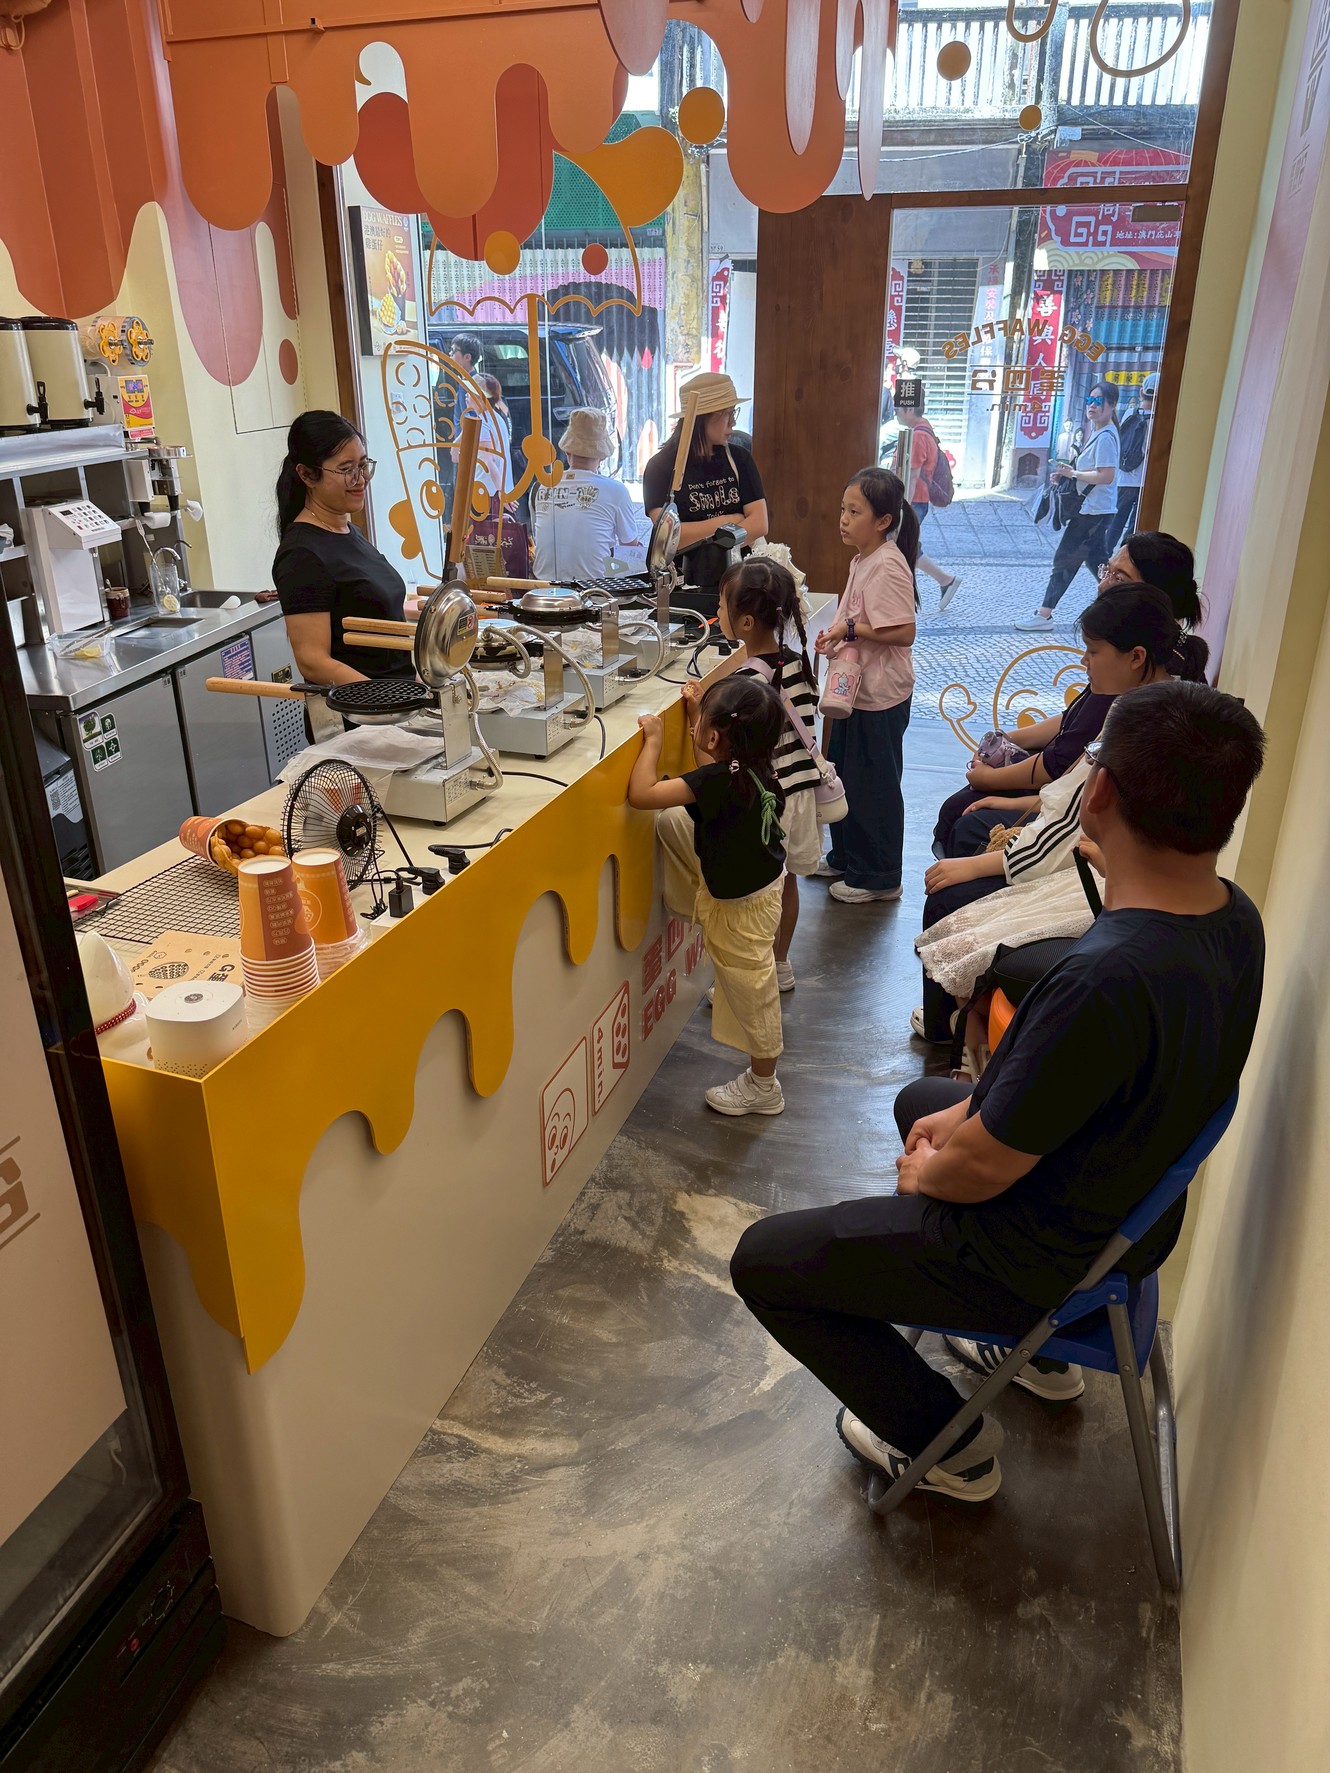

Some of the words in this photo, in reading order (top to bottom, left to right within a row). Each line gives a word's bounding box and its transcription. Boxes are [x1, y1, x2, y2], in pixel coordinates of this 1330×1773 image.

[900, 381, 915, 397] 推
[706, 478, 727, 488] forget
[641, 968, 677, 1042] EGG
